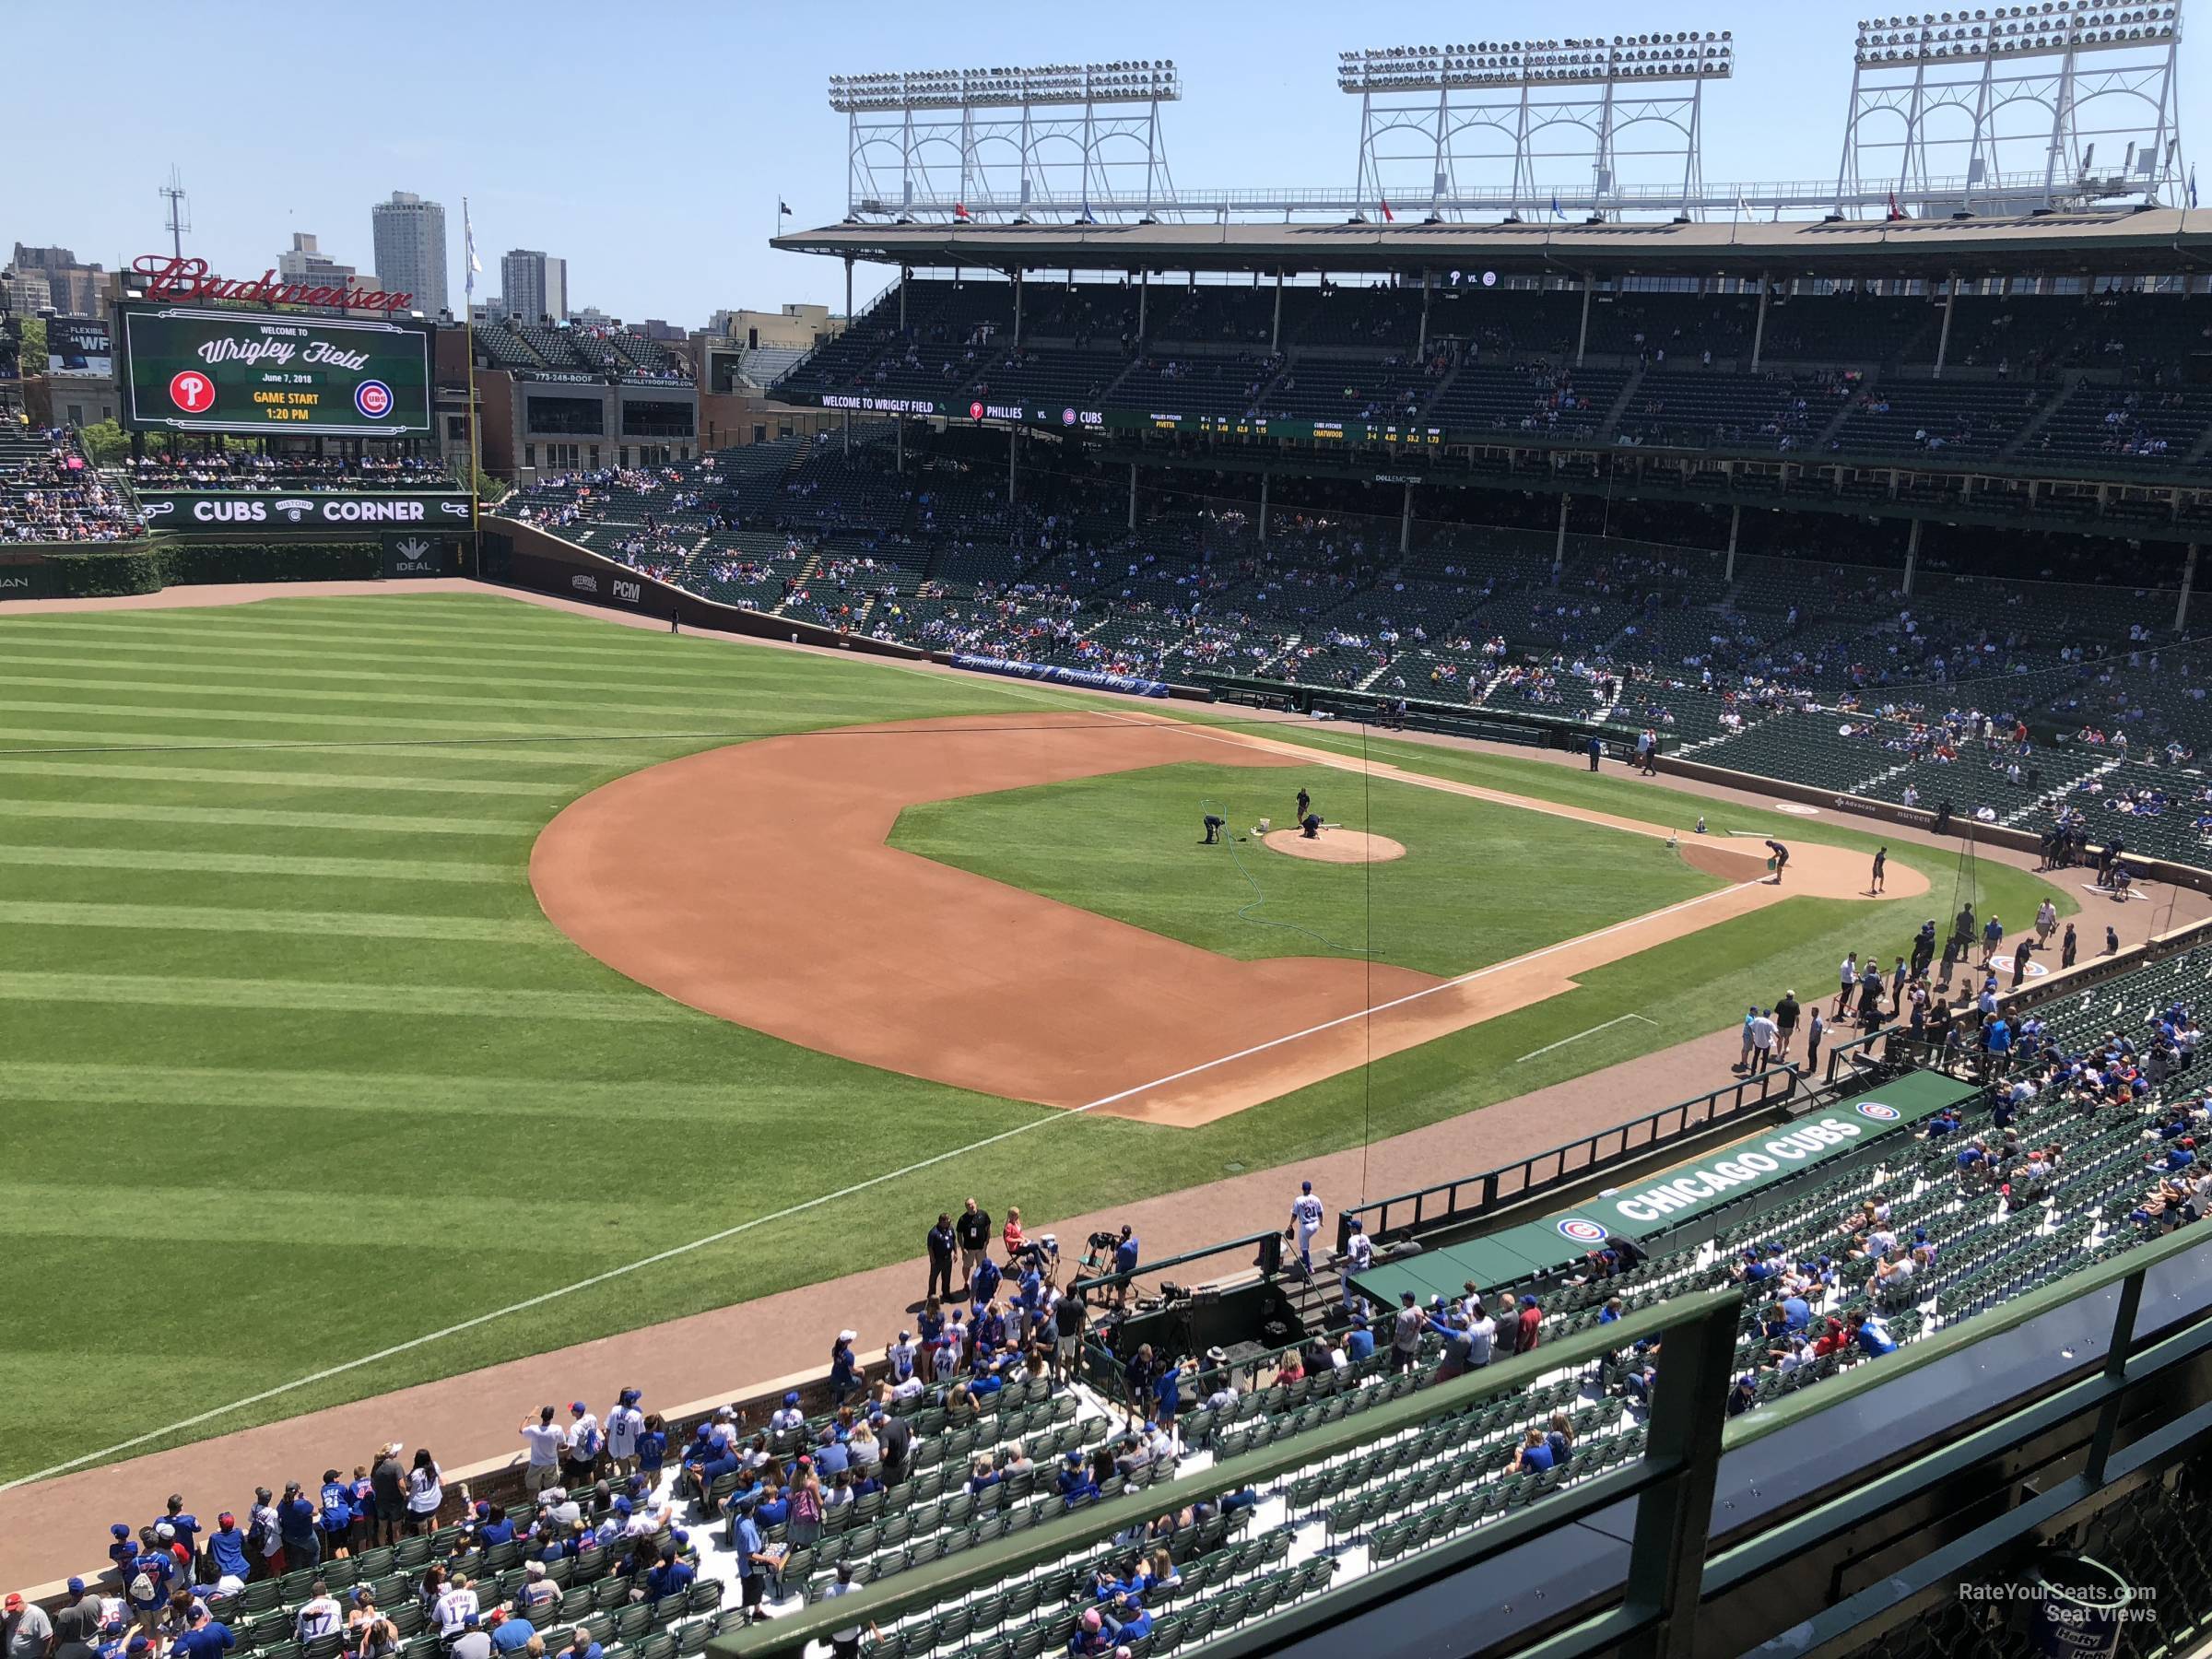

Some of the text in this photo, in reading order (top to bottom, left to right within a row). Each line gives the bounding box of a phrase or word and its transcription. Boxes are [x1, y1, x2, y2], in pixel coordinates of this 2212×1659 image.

[133, 254, 413, 311] Budweiser
[260, 325, 309, 336] WELCOME TO
[198, 337, 371, 371] Wrigley Field
[262, 372, 312, 384] June 7, 2018
[253, 392, 319, 405] GAME START
[822, 394, 934, 413] WELCOME TO WRIGLEY FIELD
[266, 408, 309, 420] 1:20 PM
[986, 406, 1023, 418] PHILLIES
[1037, 410, 1047, 419] VS.
[1079, 411, 1103, 424] CUBS
[1156, 420, 1175, 429] PIVETTA
[1312, 429, 1343, 439] CHATWOOD
[1406, 434, 1419, 443] 53.2
[194, 501, 267, 522] CUBS
[276, 500, 312, 510] HISTORY
[323, 501, 425, 522] CORNER
[396, 562, 432, 571] IDEAL
[613, 580, 641, 600] PCM
[959, 655, 1004, 670] Reynolds
[1004, 660, 1033, 676] Wrap
[1055, 667, 1106, 686] Reynolds
[1105, 673, 1136, 690] Wrap
[1844, 800, 1877, 811] Advocate
[1897, 811, 1931, 823] nuveen
[1616, 1118, 1862, 1221] CHICAGO CUBS
[616, 1422, 626, 1436] 9
[449, 1604, 471, 1625] 17
[312, 1613, 333, 1636] 17
[2057, 1629, 2099, 1646] Hefty
